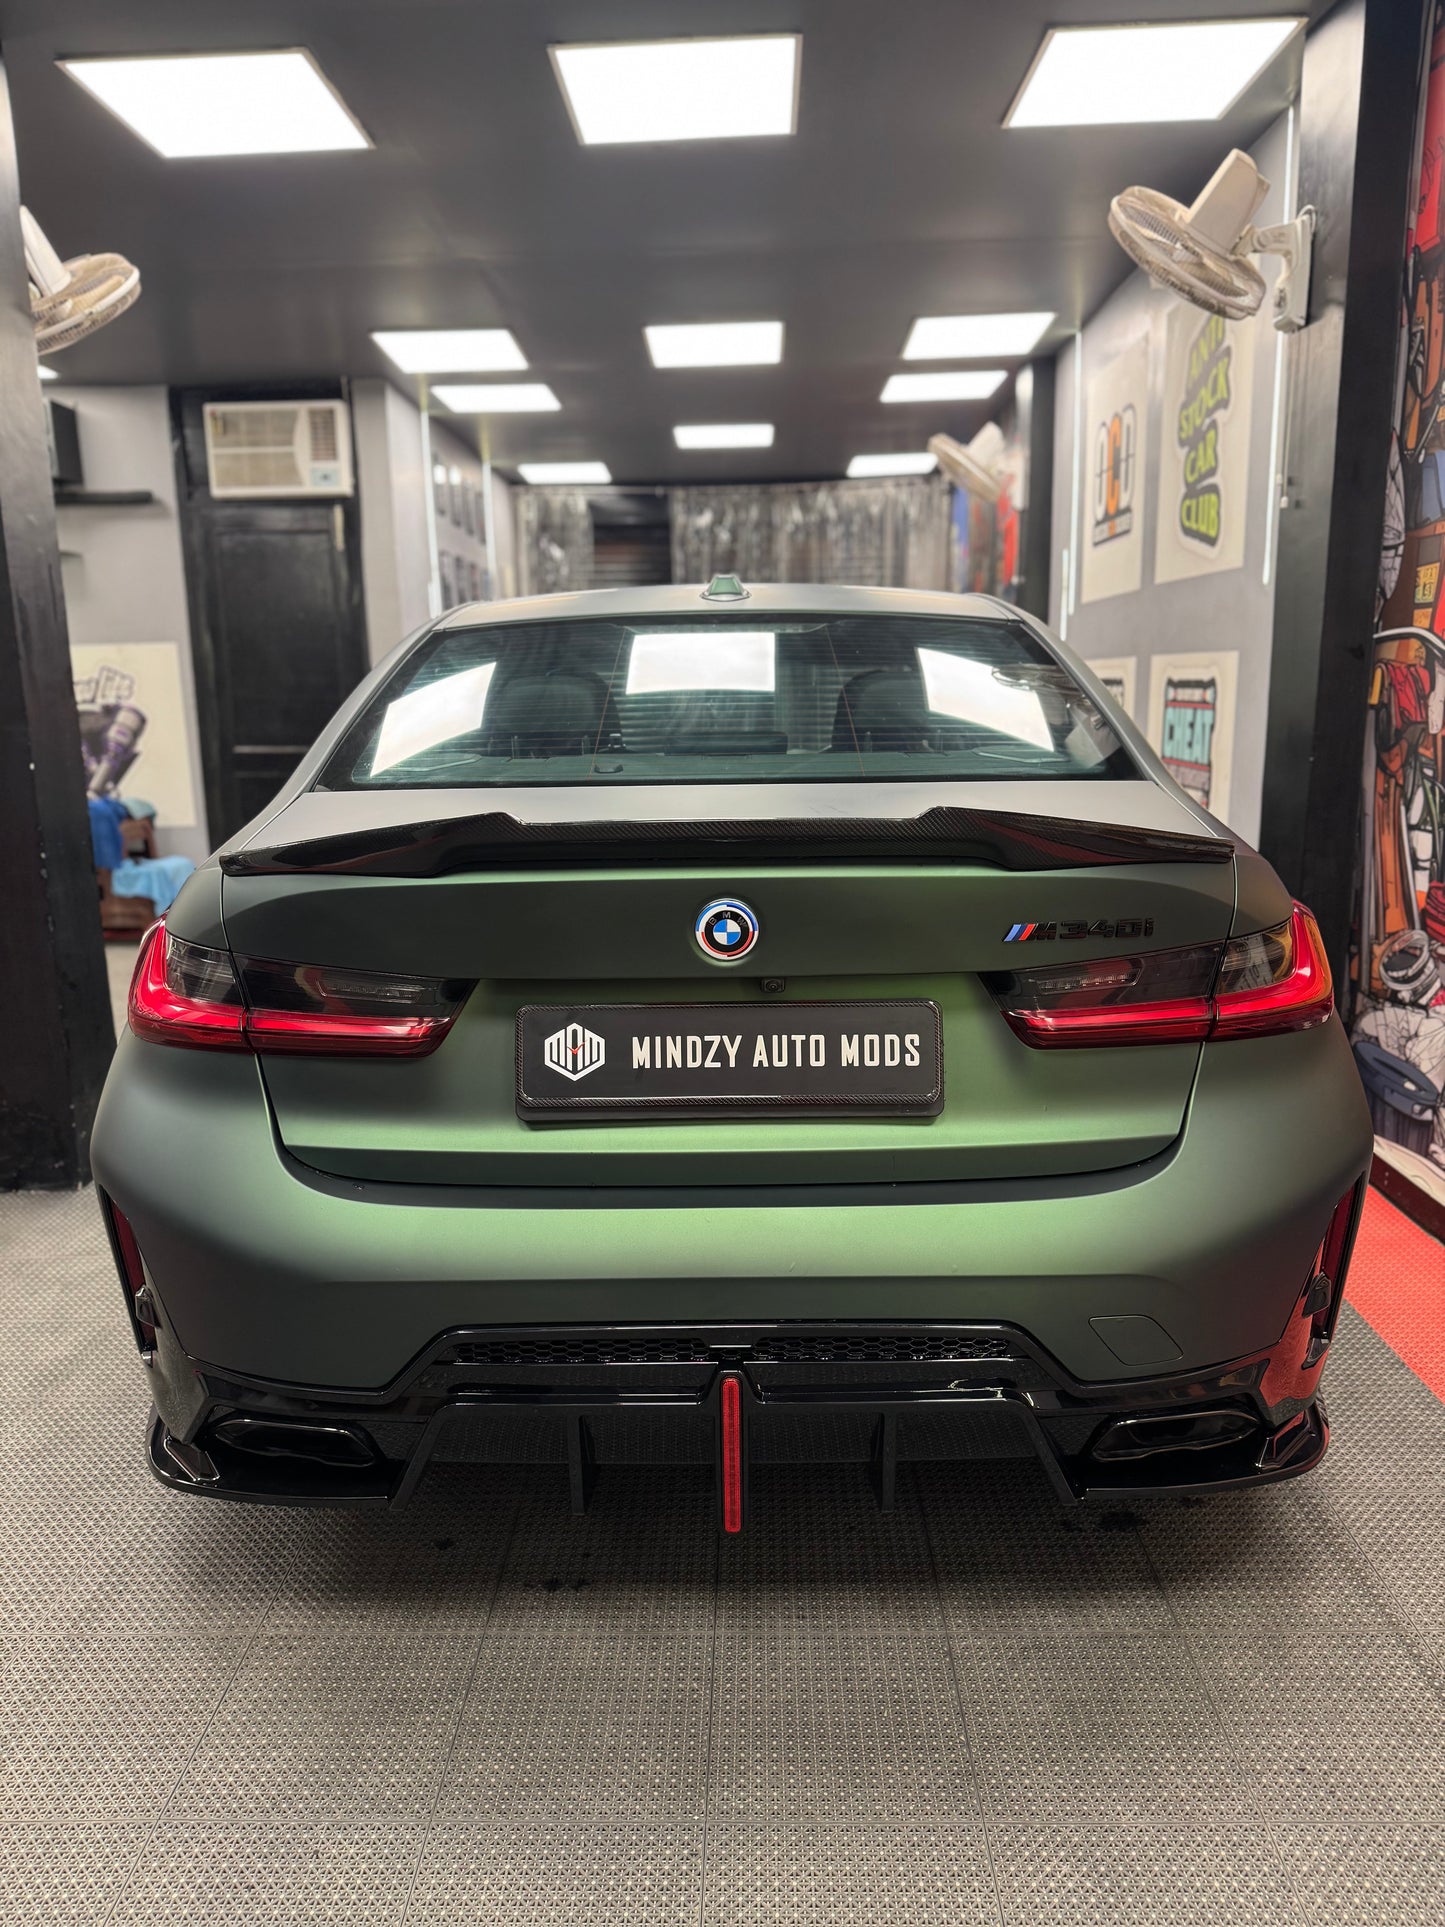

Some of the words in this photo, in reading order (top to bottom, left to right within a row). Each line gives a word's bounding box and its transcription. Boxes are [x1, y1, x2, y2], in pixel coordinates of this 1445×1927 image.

[1180, 356, 1229, 440] STOCK
[1095, 403, 1136, 523] OCD
[1185, 427, 1217, 484] CAR
[1181, 492, 1219, 539] CLUB
[1163, 706, 1214, 766] CHEAT
[632, 1034, 743, 1069] MINDZY
[752, 1034, 826, 1067] AUTO
[841, 1033, 920, 1067] MODS
